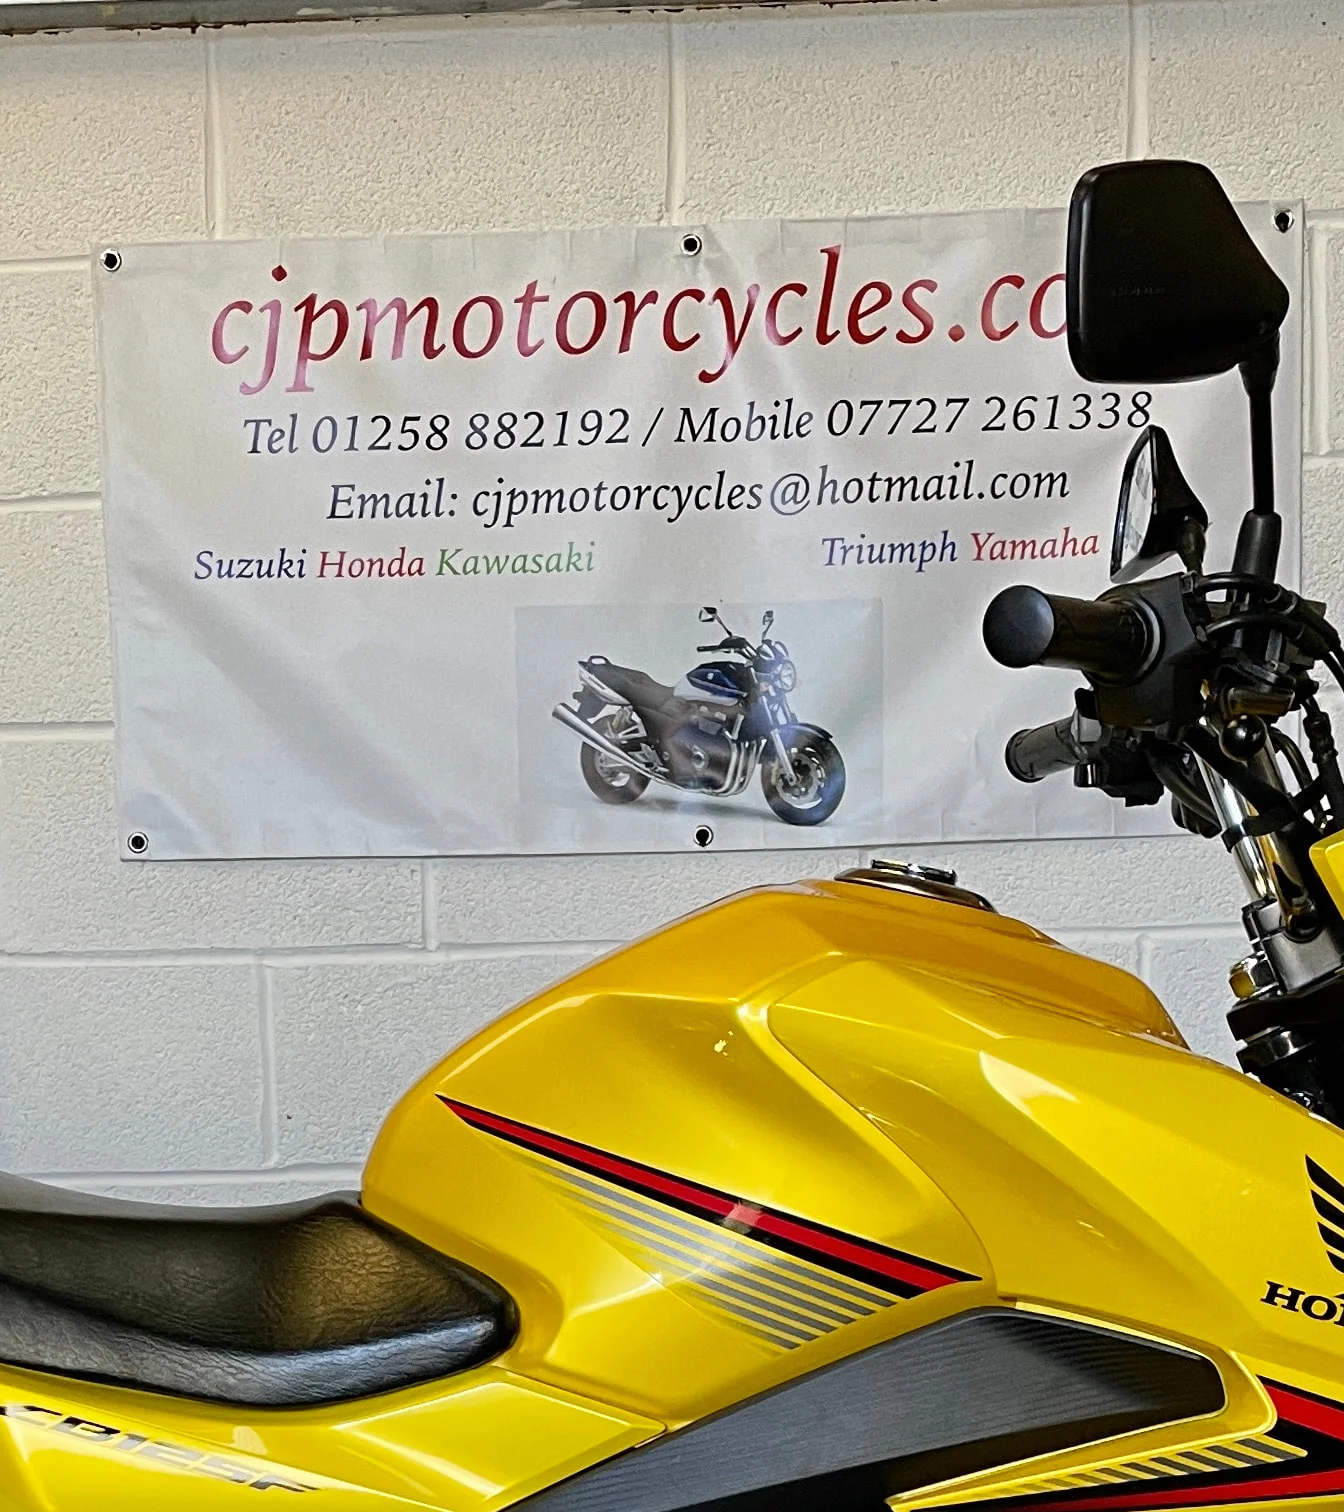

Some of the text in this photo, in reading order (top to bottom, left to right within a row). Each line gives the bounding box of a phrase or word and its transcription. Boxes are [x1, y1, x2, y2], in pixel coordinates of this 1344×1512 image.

[243, 391, 1153, 453] Tel 01258 882192 / Mobile 07727 261338
[326, 461, 1070, 528] Email: cjpmotorcycles@hotmail.com
[194, 541, 596, 581] Suzuki Honda Kawasaki
[821, 526, 1100, 573] Triumph Yamaha
